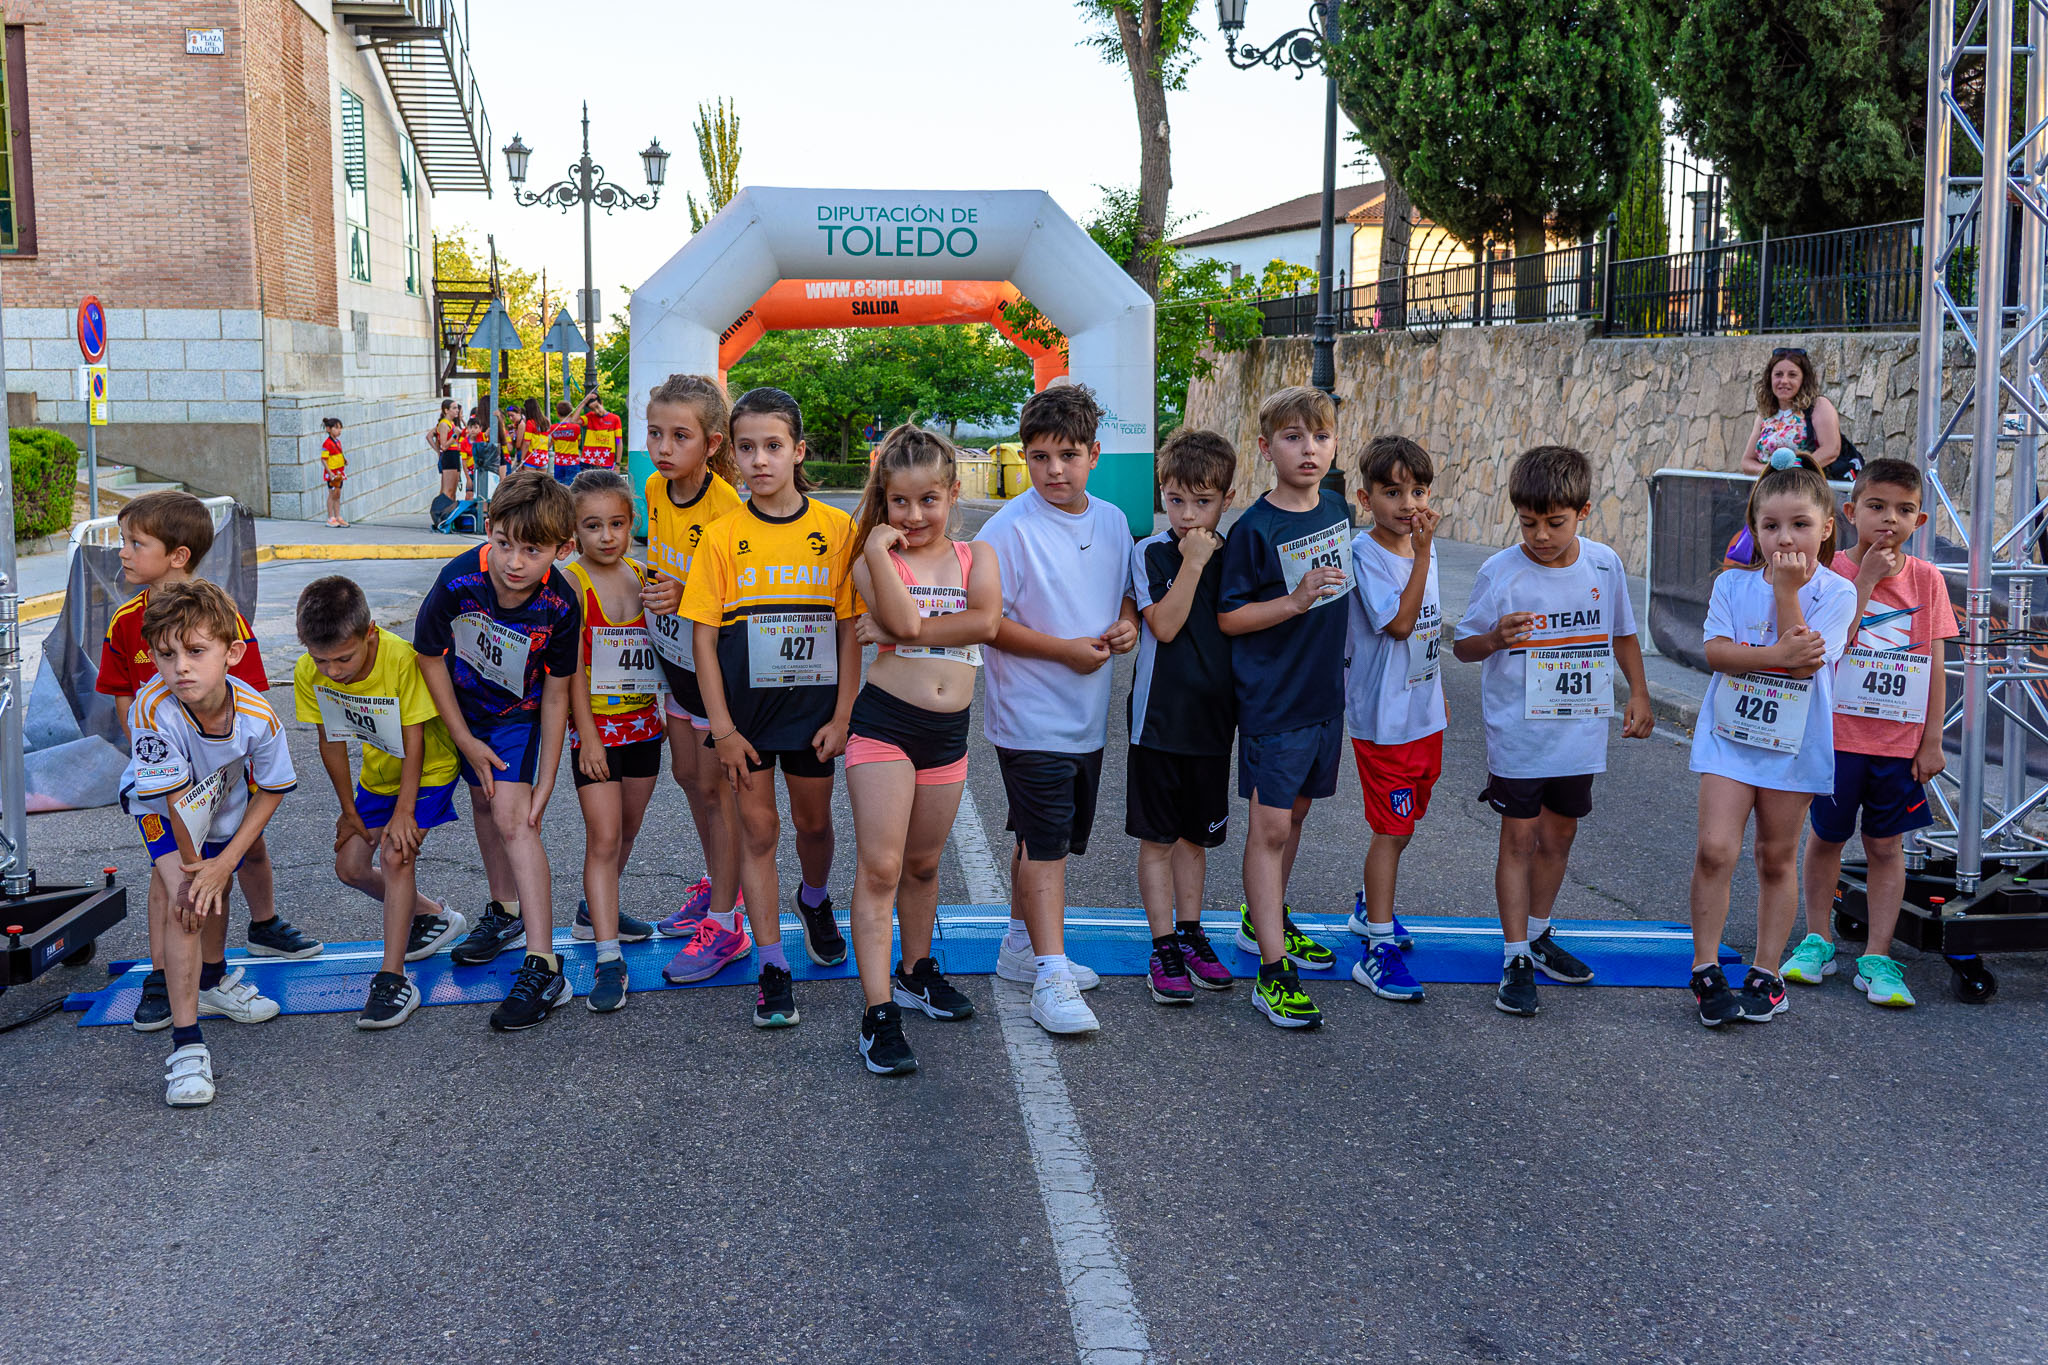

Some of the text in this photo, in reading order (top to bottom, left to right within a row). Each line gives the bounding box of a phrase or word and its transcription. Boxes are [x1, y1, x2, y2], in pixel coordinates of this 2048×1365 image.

[817, 204, 978, 223] DIPUTACIÓN DE
[817, 225, 978, 258] TOLEDO
[852, 300, 900, 316] SALIDA
[1288, 538, 1308, 551] LEGUA
[1308, 530, 1336, 544] NOCTURNA
[764, 565, 830, 586] TEAM
[910, 586, 932, 595] LEGUA
[656, 614, 680, 642] 432
[760, 615, 782, 624] LEGUA
[782, 614, 816, 622] NOCTURNA
[507, 631, 528, 646] UGENA
[604, 628, 624, 636] LEGUA
[476, 631, 503, 667] 438
[780, 636, 815, 660] 427
[1426, 638, 1440, 662] 42
[1530, 650, 1538, 659] XI
[1538, 650, 1560, 660] LEGUA
[1560, 650, 1592, 659] NOCTURNA
[1852, 648, 1872, 658] LEGUA
[1872, 650, 1909, 662] NOCTURNA
[618, 648, 655, 671] 440
[1555, 672, 1592, 695] 431
[1747, 674, 1784, 688] NOCTURNA
[1784, 680, 1808, 692] UGENA
[1862, 671, 1907, 697] 439
[340, 693, 372, 705] NOCTURNA
[372, 697, 395, 706] UGENA
[1734, 694, 1780, 724] 426
[344, 708, 377, 734] 429
[142, 744, 160, 756] 14
[138, 768, 179, 776] FOUNDATION
[179, 799, 188, 809] XI
[186, 784, 206, 804] LEGUA
